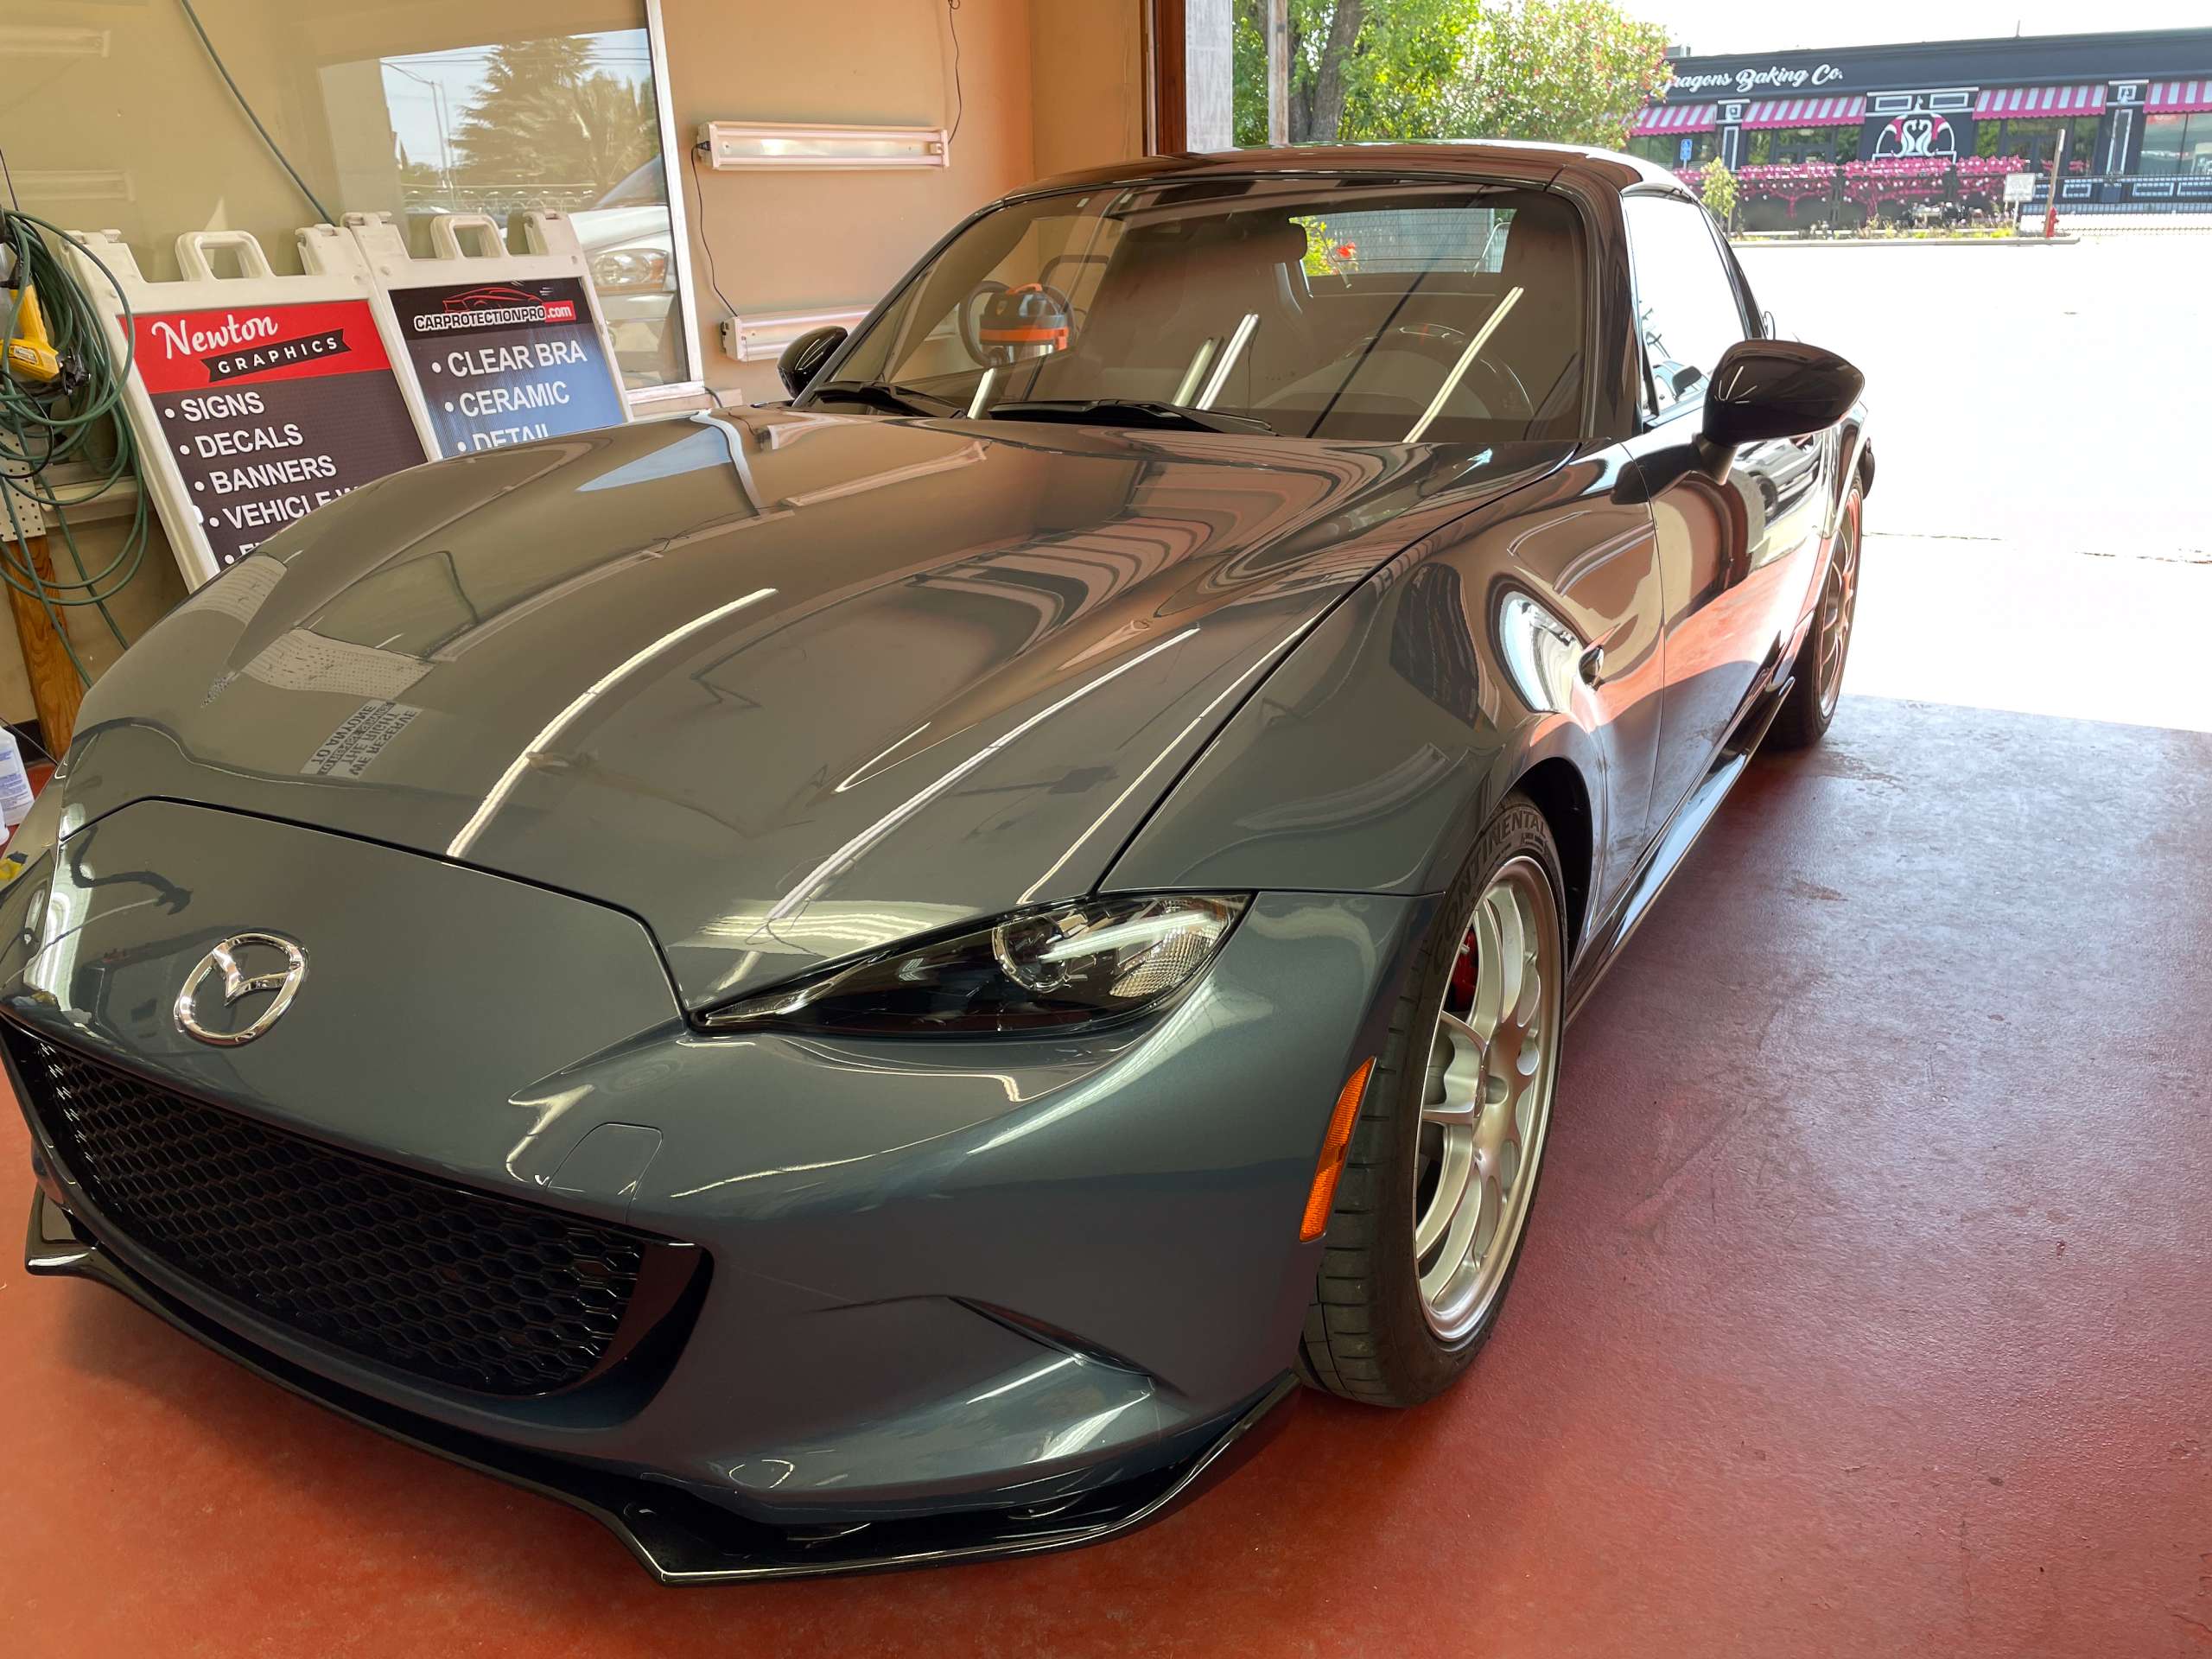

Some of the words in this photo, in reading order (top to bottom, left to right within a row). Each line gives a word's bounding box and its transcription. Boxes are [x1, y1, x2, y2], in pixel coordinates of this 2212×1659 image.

[1735, 66, 1808, 92] Baking
[1811, 64, 1843, 85] Co.
[151, 314, 278, 359] Newton
[414, 305, 572, 332] CARPROTECTIONPRO.com
[218, 337, 337, 373] GRAPHICS
[448, 345, 534, 377] CLEAR
[535, 340, 588, 366] BRA
[181, 391, 265, 422] SIGNS
[460, 381, 569, 417] CERAMIC
[194, 423, 303, 458] DECALS
[209, 455, 337, 494] BANNERS
